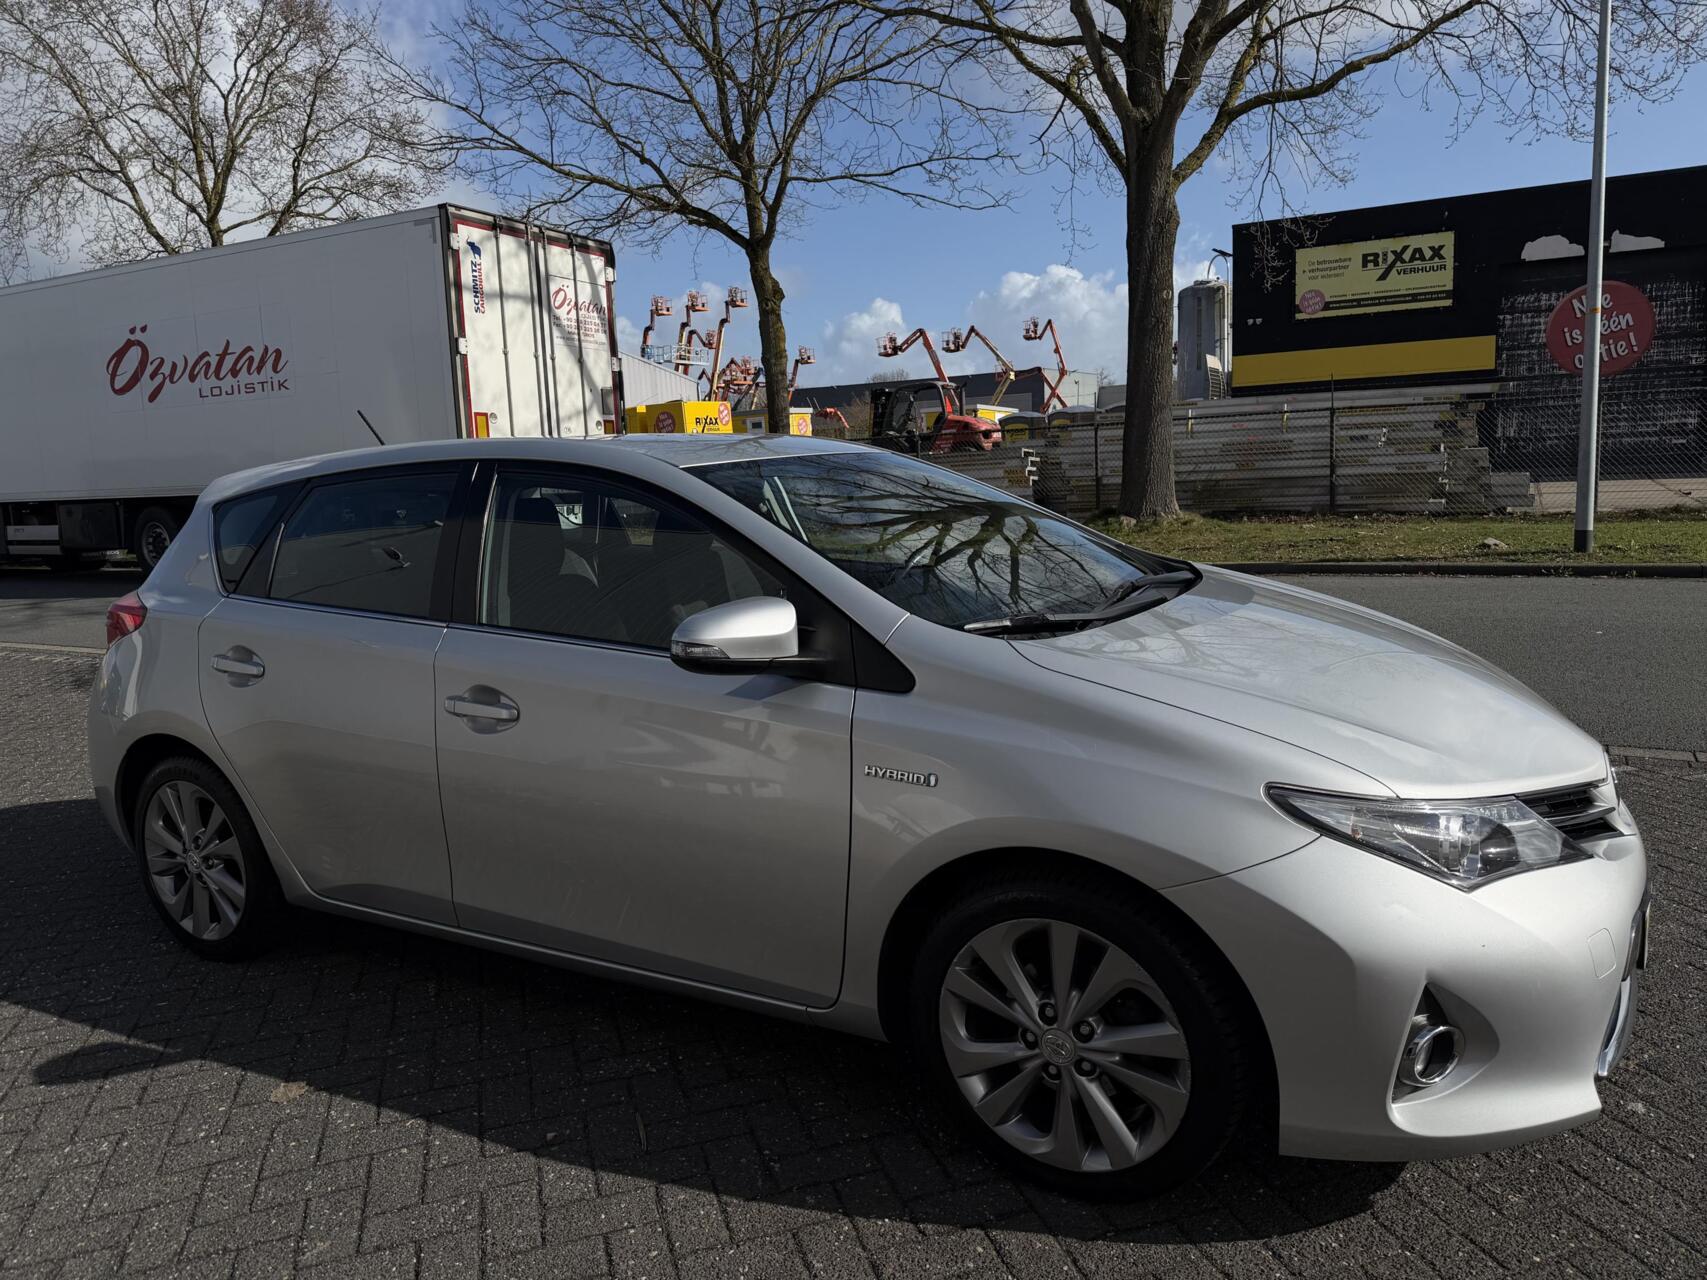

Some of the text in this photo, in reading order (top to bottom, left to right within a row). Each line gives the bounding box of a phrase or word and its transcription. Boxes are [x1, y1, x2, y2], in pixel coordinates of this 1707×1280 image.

[471, 260, 481, 314] SCHMITZ
[1396, 264, 1447, 276] VERHUUR
[476, 262, 486, 315] CARGOBULL
[1572, 293, 1613, 318] Ne
[1563, 311, 1634, 346] is één
[106, 324, 289, 404] Özvatan
[1574, 331, 1639, 369] otie!
[864, 764, 926, 786] HYBRID
